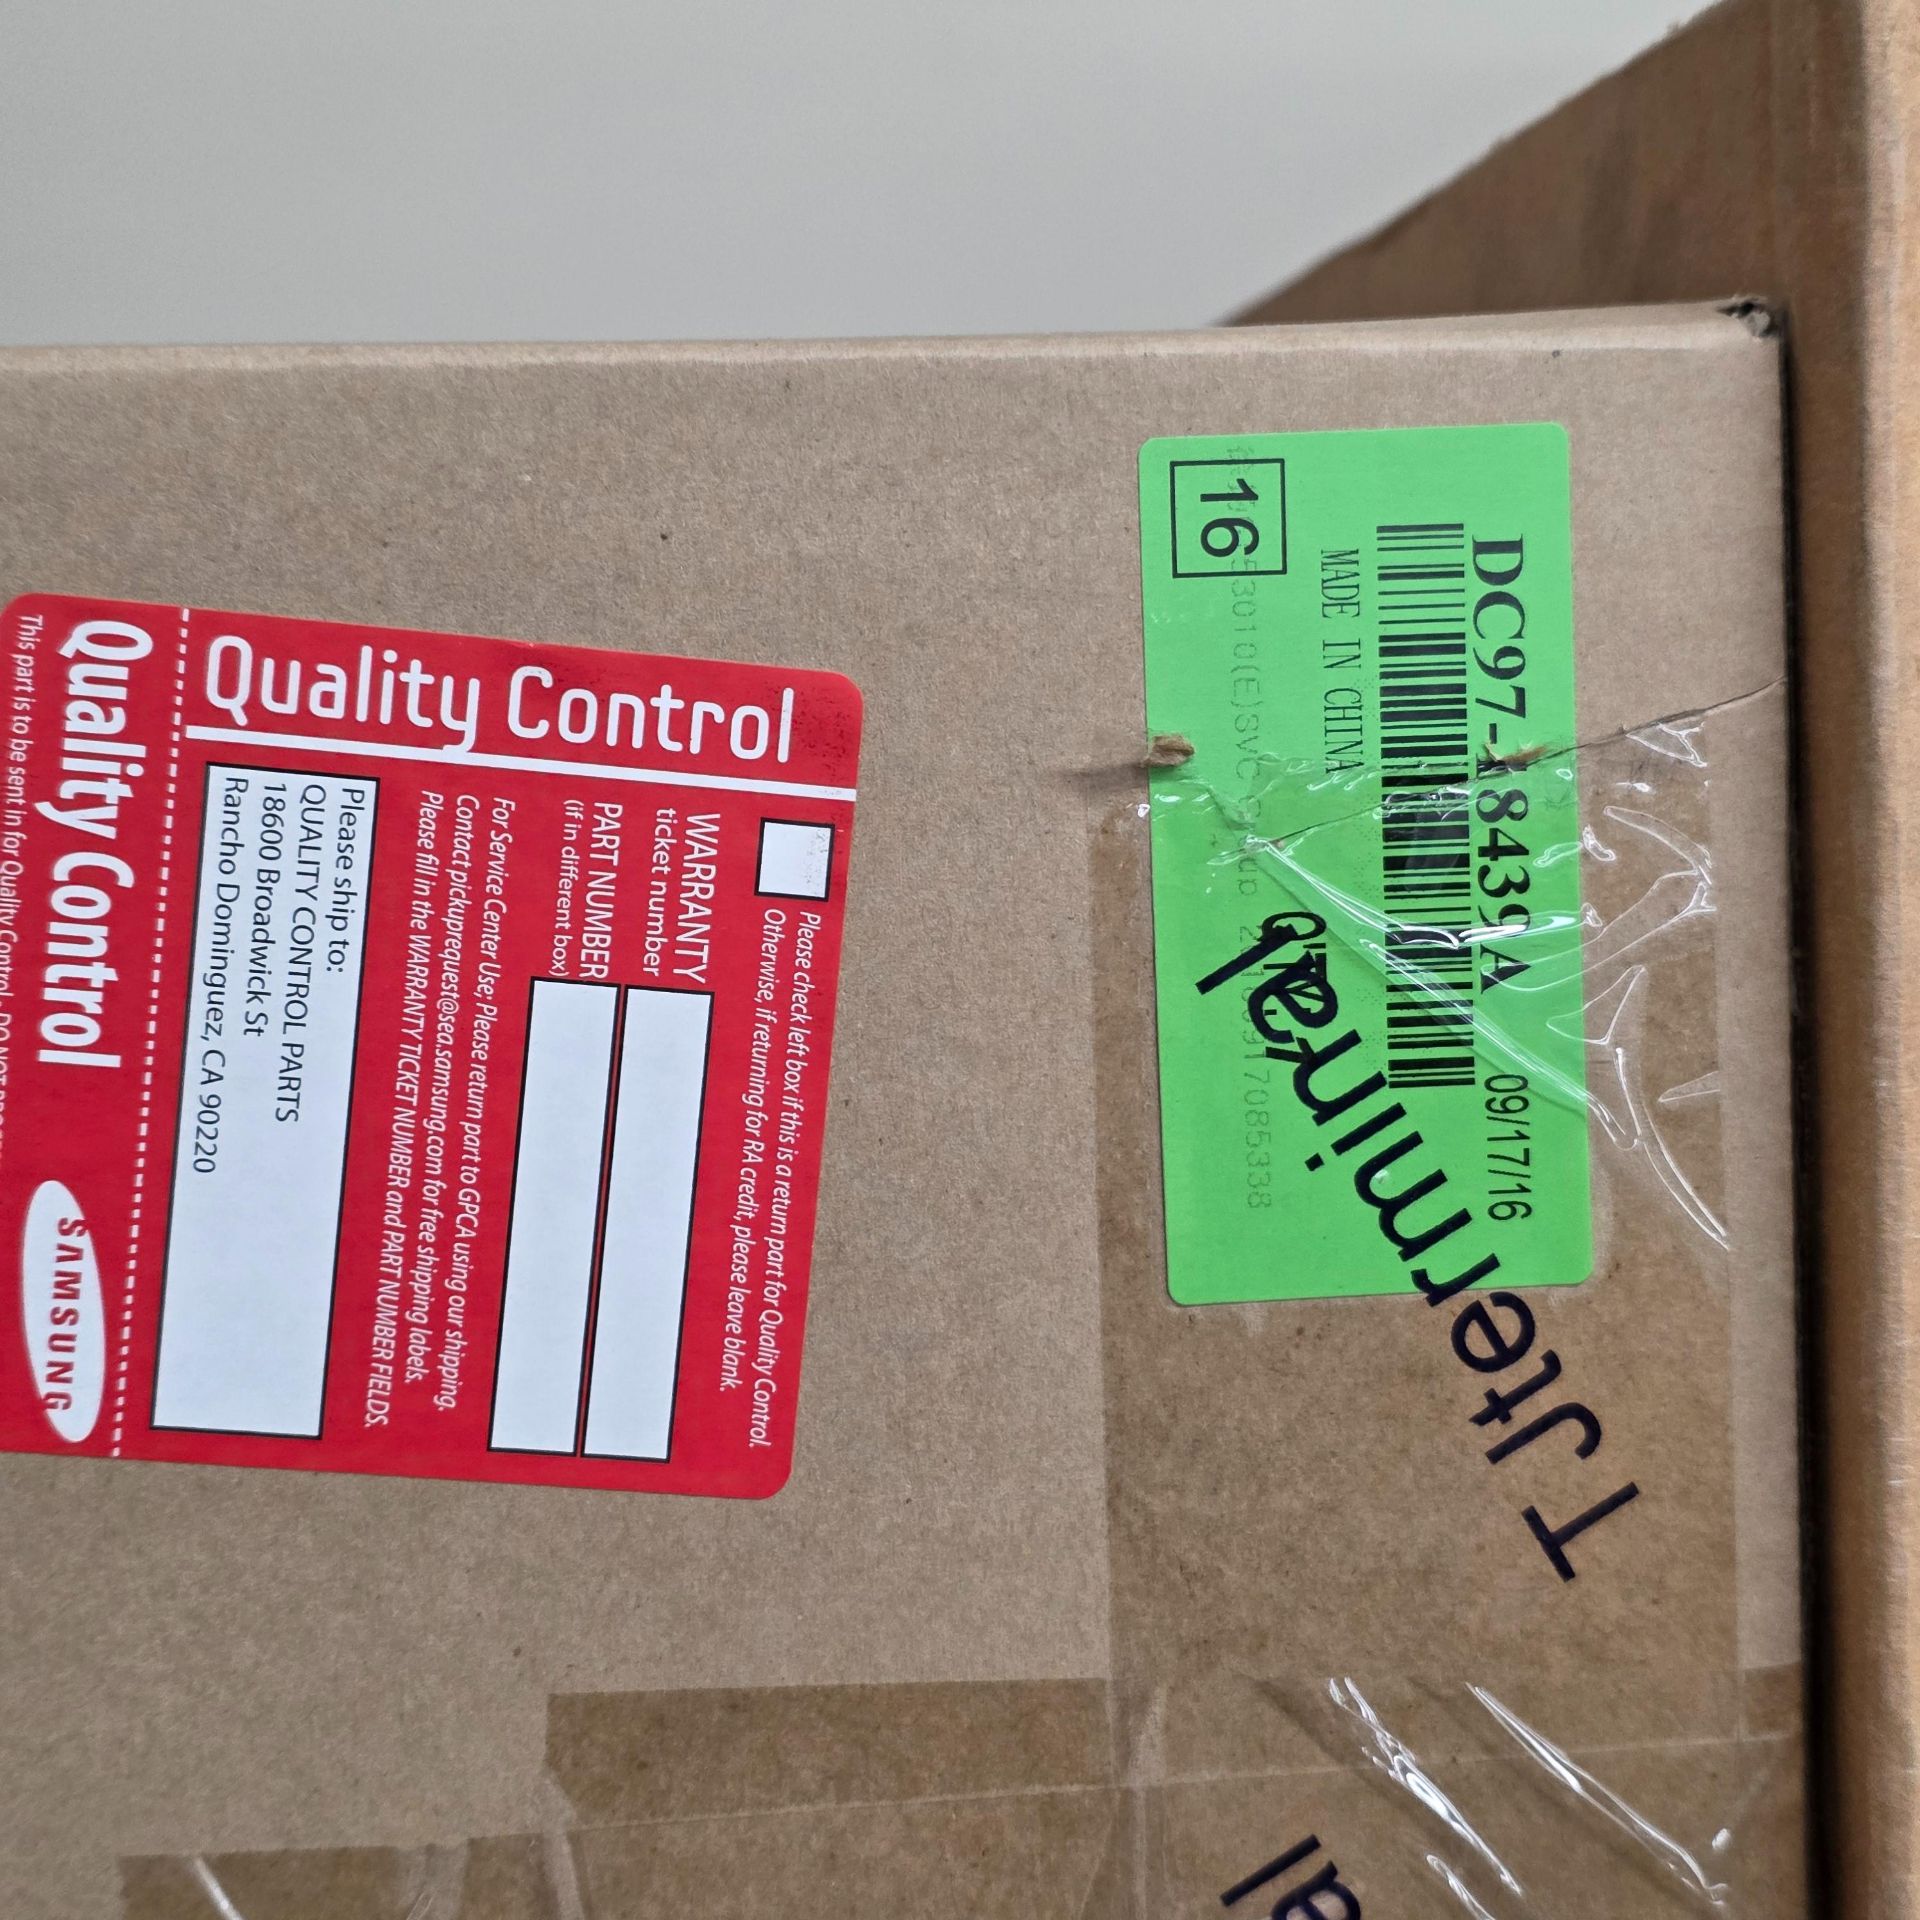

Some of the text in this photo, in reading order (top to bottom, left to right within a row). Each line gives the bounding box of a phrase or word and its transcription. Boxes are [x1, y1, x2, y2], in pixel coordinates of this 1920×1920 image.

[1200, 478, 1259, 557] 16
[10, 653, 35, 692] part
[12, 697, 36, 711] is
[17, 615, 43, 650] This
[207, 637, 794, 764] Quality Control
[1321, 549, 1364, 774] MADE IN CHINA
[6, 766, 26, 805] sent
[9, 738, 34, 762] be
[11, 716, 33, 735] to
[0, 860, 24, 927] Quality
[2, 831, 27, 857] for
[3, 810, 27, 826] in
[34, 620, 154, 1069] Quality Control
[325, 788, 365, 973] Please ship to:
[548, 799, 584, 977] (if in different box)
[578, 802, 623, 979] PART NUMBER
[642, 808, 678, 978] ticket number
[672, 813, 721, 984] WARRANTY
[193, 777, 248, 1174] Rancho Dominguez, CA 90220
[243, 784, 286, 1037] 18600 Broadwick St
[275, 784, 326, 1122] QUALITY CONTROL PARTS
[364, 790, 444, 1428] Please fill in the WARRANTY TICKET NUMBER and PART NUMBER FIELDS.
[404, 794, 480, 1384] Contact pickuprequest@sea.samsung.com for free shipping labels.
[433, 797, 516, 1412] For Service Center Use; Please return part to GPCA using our shipping.
[719, 909, 787, 1392] Otherwise, if returning for RA credit, please leave blank.
[1484, 1074, 1532, 1221] 09/17/16
[748, 911, 821, 1448] Please check left box if this is a return part for Quality Control.
[43, 1217, 87, 1411] SAMSUNG
